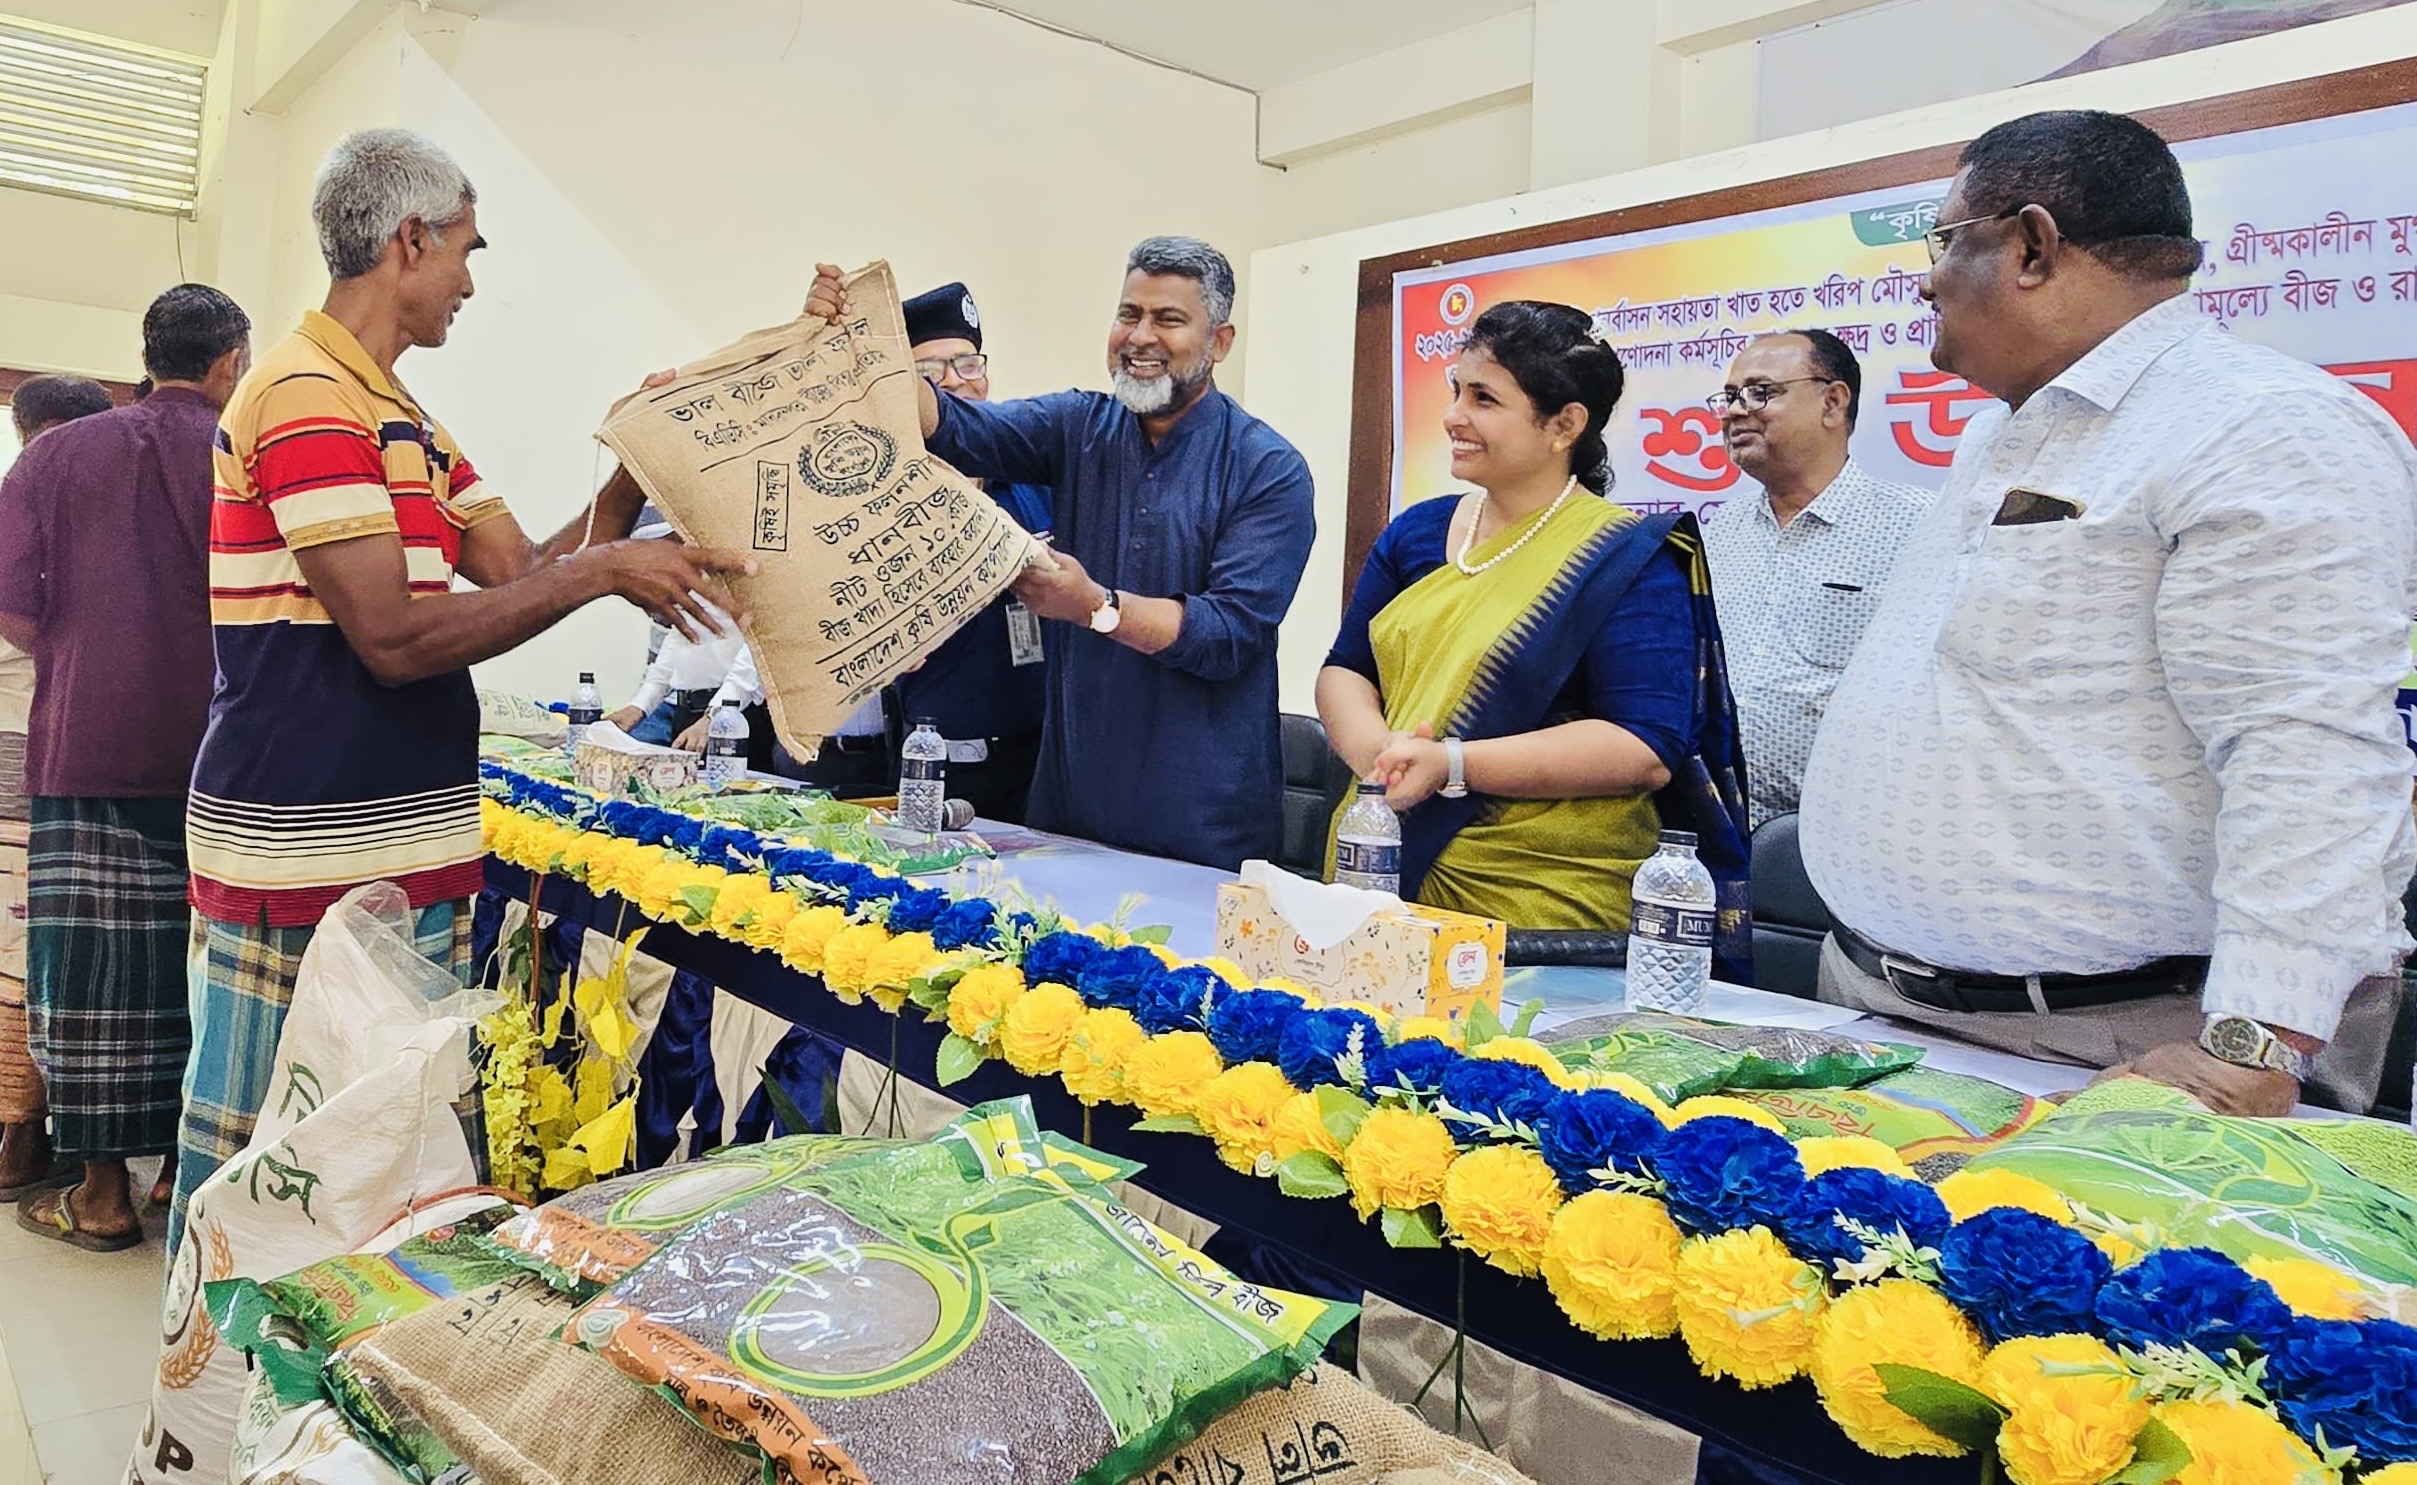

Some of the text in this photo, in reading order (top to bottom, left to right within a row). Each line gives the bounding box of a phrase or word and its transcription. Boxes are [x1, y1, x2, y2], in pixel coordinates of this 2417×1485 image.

[1657, 295, 1720, 328] সহায়তা
[1727, 290, 1763, 319] খাত
[1768, 287, 1807, 317] হতে
[1813, 273, 1864, 309] খরিপ
[1872, 265, 1927, 307] মৌসু
[2226, 211, 2378, 266] গ্রীষ্মকালীন
[2386, 215, 2417, 256] মু
[1617, 343, 1671, 371] ণোদনা
[1880, 322, 1897, 346] ও
[2194, 285, 2274, 331] ামূল্যে
[2281, 269, 2342, 313] বীজ
[2352, 275, 2376, 303] ও
[2388, 267, 2417, 304] রা
[664, 393, 724, 422] ভাল
[1640, 406, 1742, 492] শু
[813, 457, 936, 545] উচ্চ ফলনশী
[829, 575, 869, 609] নীট
[874, 543, 921, 584] ওজন
[920, 526, 946, 552] ১০
[829, 628, 905, 688] বাংলাদেশ
[903, 603, 935, 645] কৃষি
